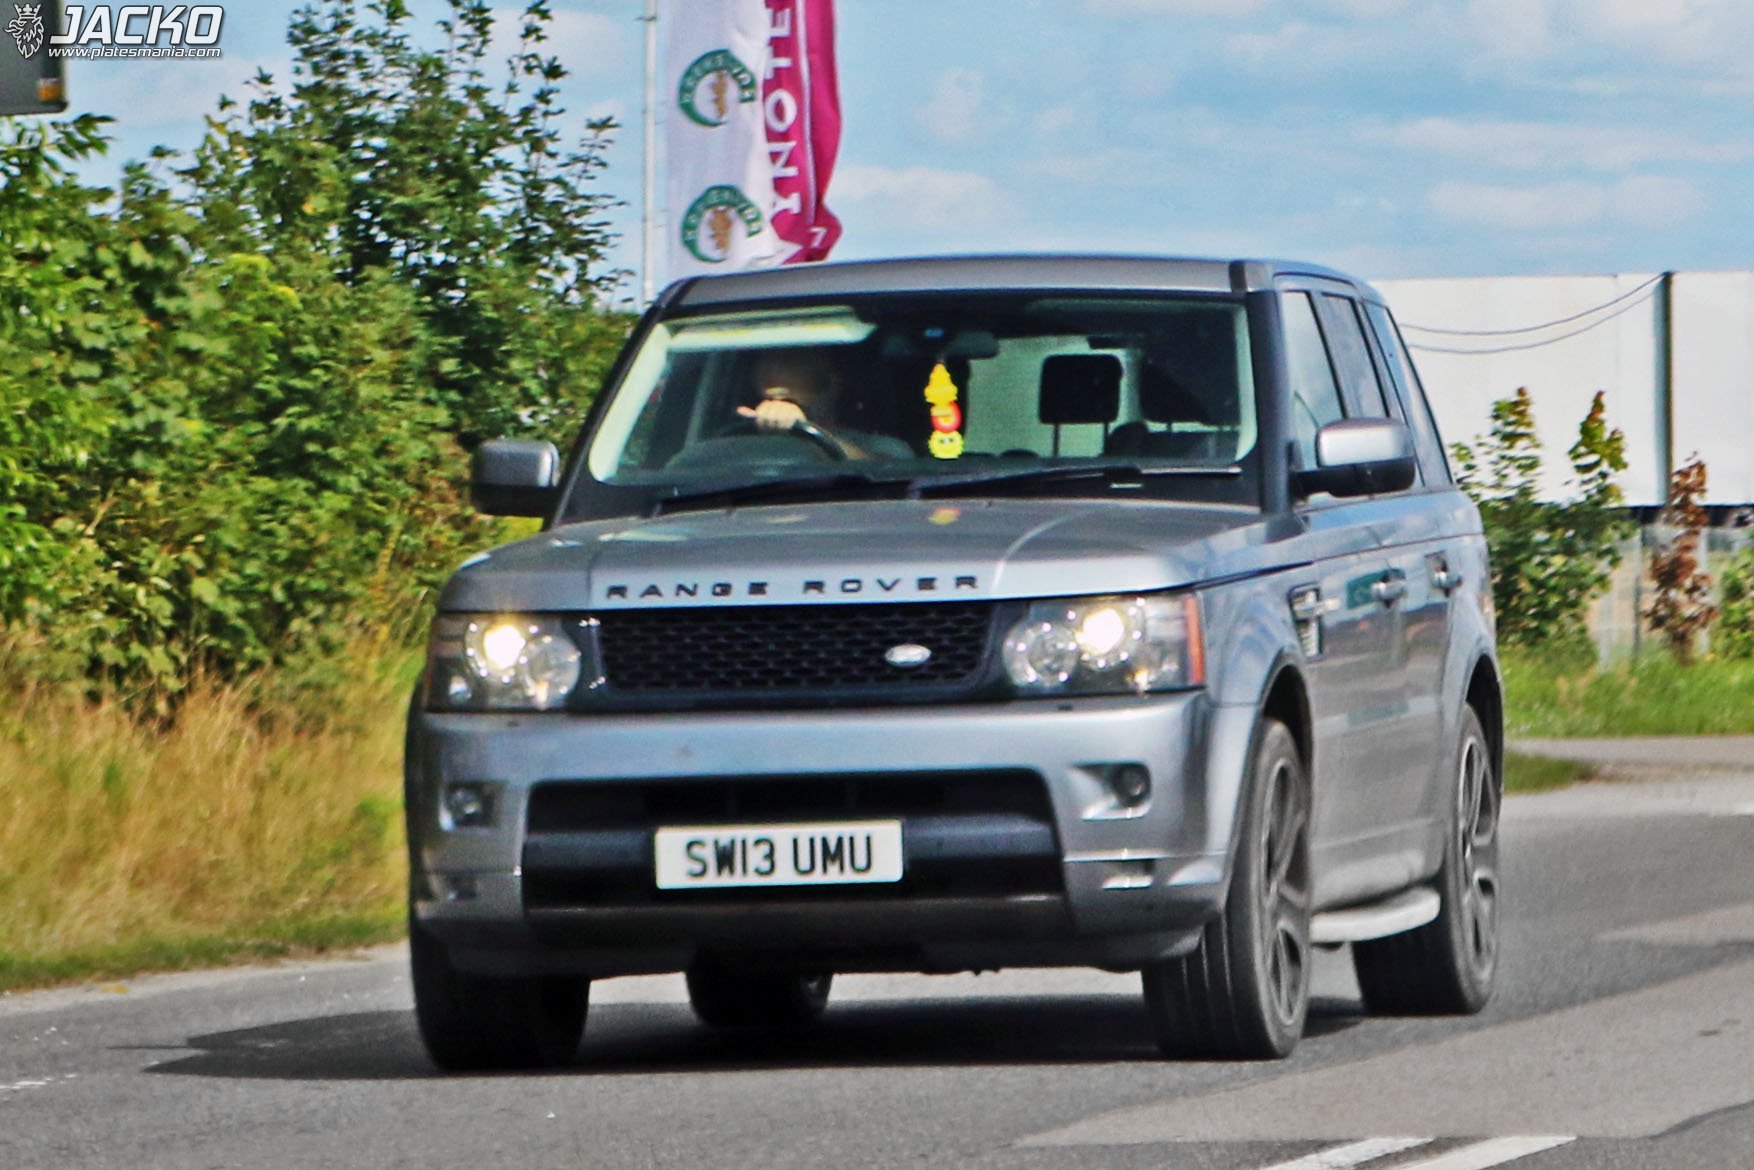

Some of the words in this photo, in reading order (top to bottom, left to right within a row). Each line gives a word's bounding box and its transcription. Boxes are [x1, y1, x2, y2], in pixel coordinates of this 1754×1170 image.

[606, 582, 768, 599] RANGE
[803, 576, 979, 595] ROVER
[686, 838, 775, 877] SW13
[793, 835, 872, 875] UMU
